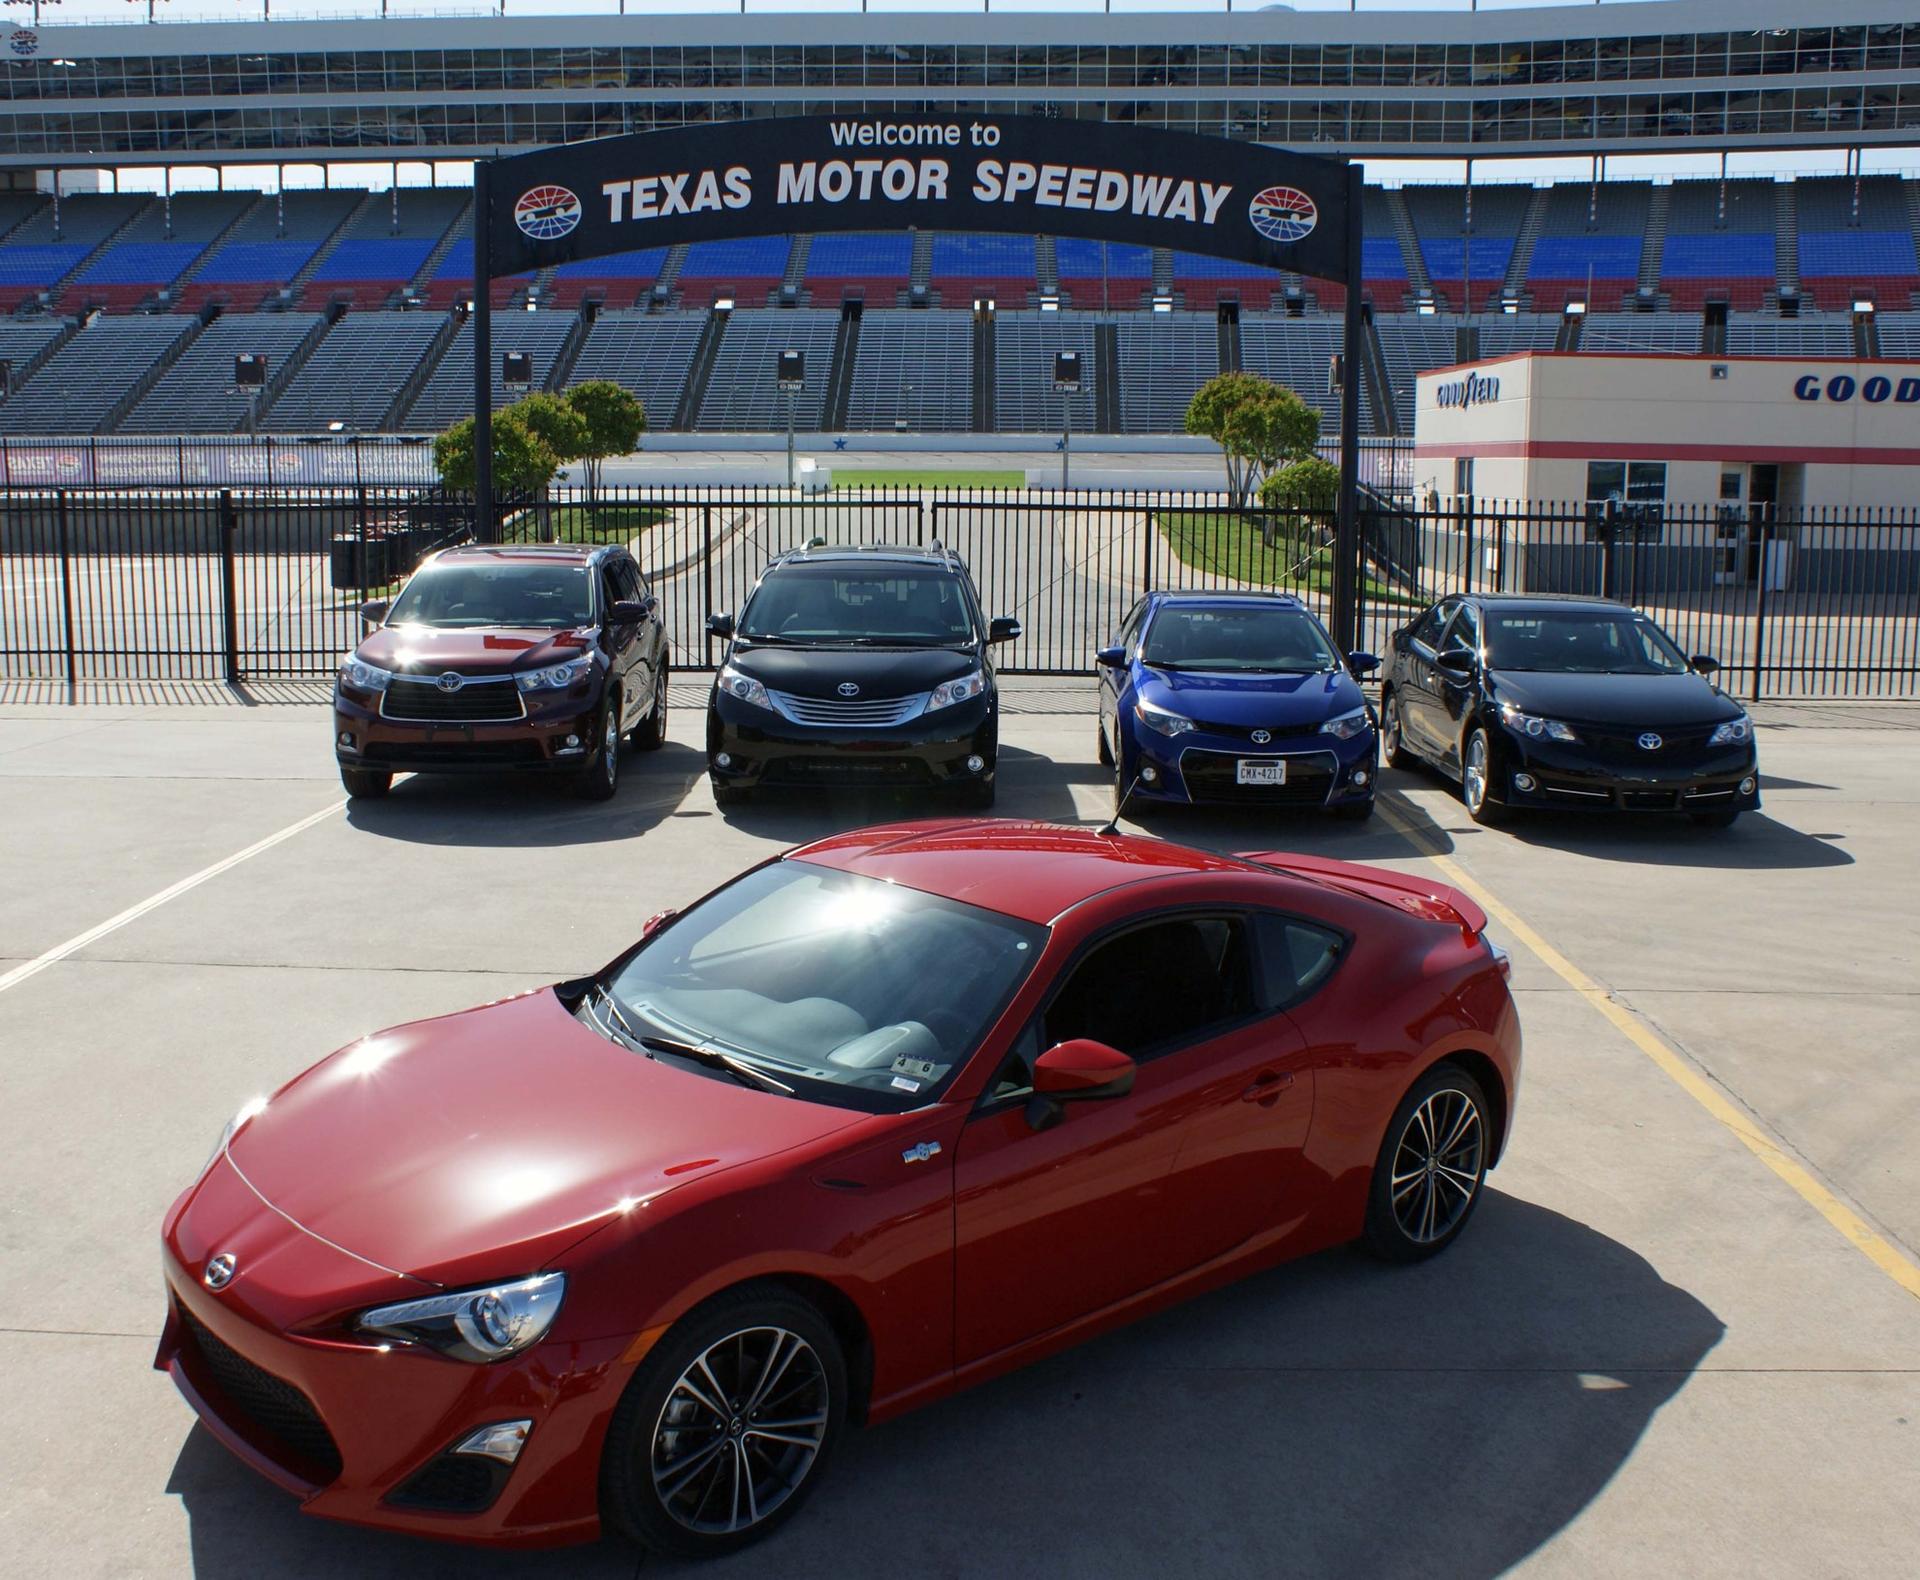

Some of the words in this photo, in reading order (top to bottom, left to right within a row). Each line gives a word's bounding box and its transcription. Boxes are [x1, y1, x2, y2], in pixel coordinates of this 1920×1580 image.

[830, 121, 961, 146] Welcome
[969, 121, 1000, 146] to
[602, 167, 752, 223] TEXAS
[777, 159, 949, 204] MOTOR
[972, 160, 1233, 225] SPEEDWAY
[1437, 372, 1499, 409] GOODYEAR
[1794, 375, 1920, 403] GOOD
